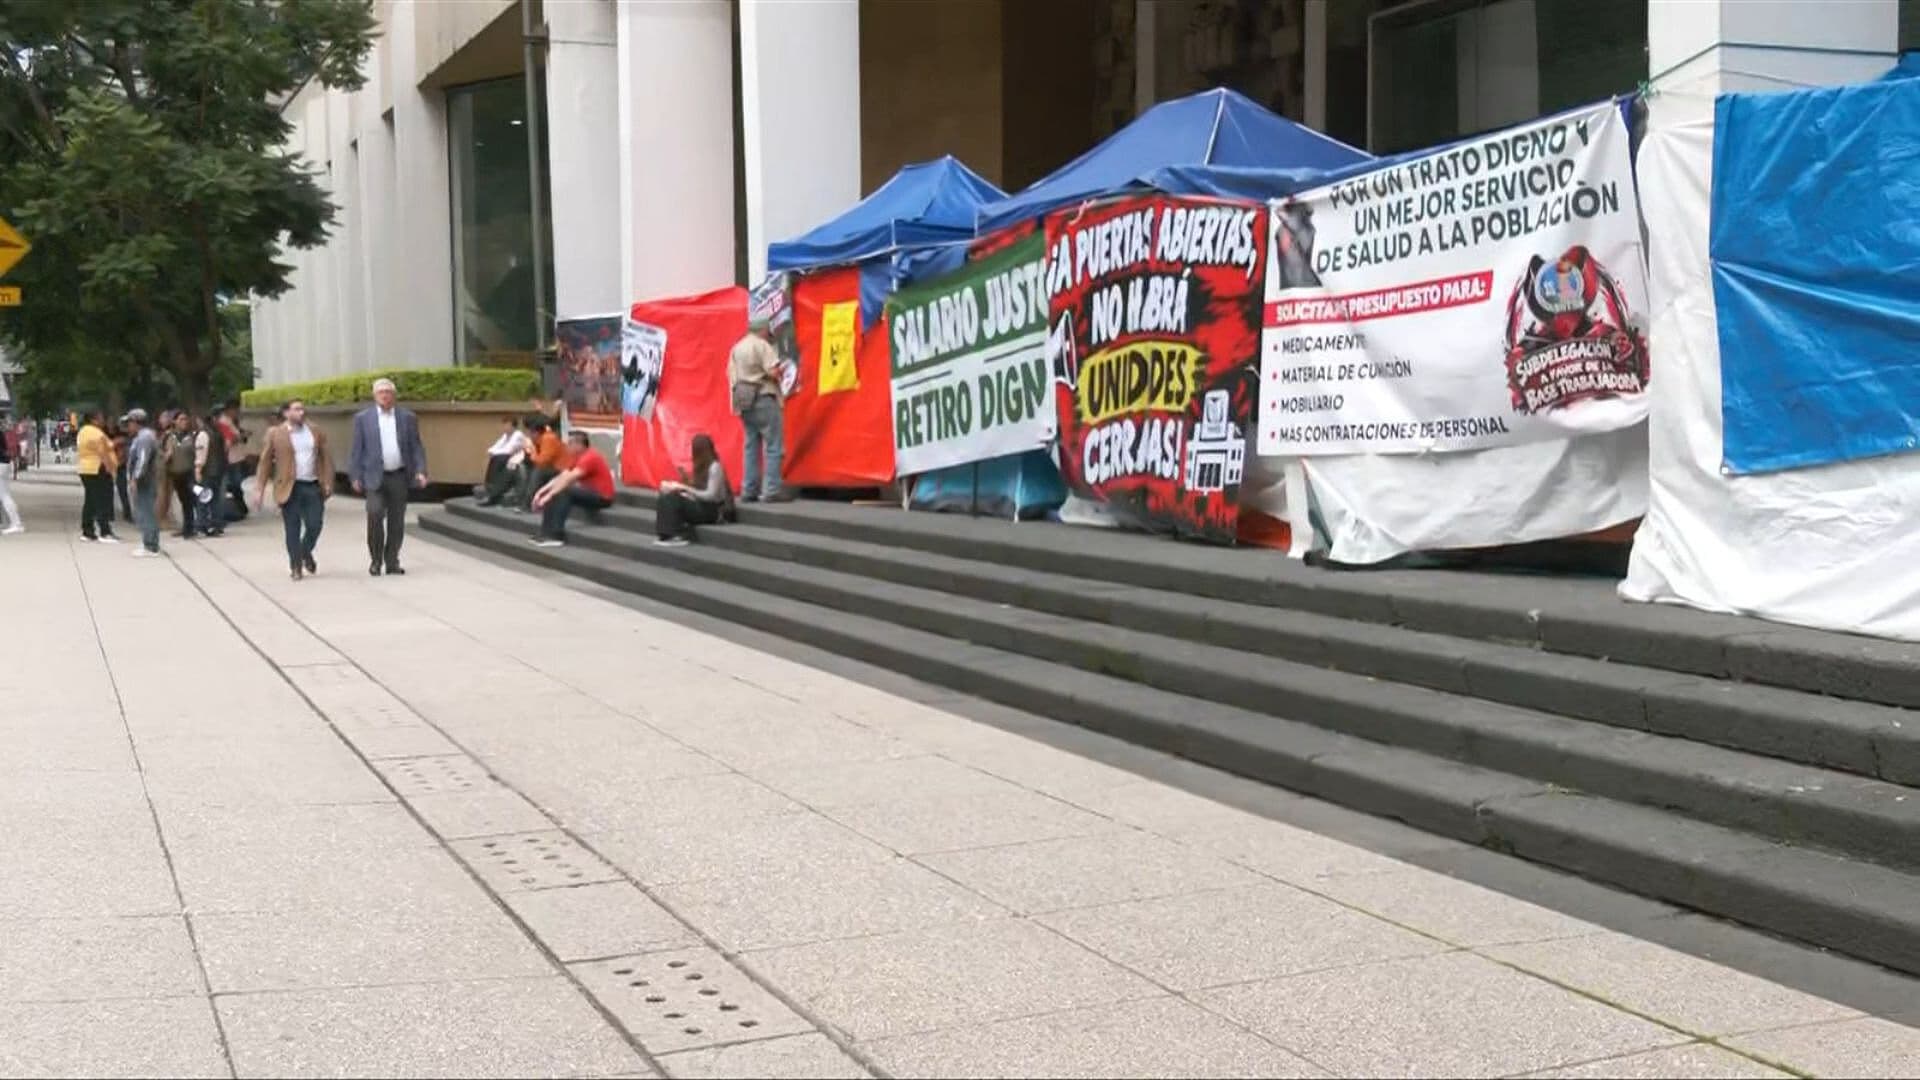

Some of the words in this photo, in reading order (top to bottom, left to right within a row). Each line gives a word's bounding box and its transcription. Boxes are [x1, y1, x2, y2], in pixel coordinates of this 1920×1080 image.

[1355, 205, 1381, 236] UN
[1387, 188, 1456, 229] MEJOR
[1462, 158, 1575, 211] SERVICIO
[1372, 168, 1402, 198] UN
[1408, 148, 1481, 190] TRATO
[1484, 125, 1567, 169] DIGNO
[1075, 206, 1153, 286] PUERTAS
[1156, 206, 1257, 280] ABIERTAS,
[1317, 246, 1343, 273] DE
[1347, 231, 1413, 270] SALUD
[1418, 227, 1434, 255] A
[1438, 219, 1468, 252] LA
[1471, 180, 1619, 245] POBLACIÓN
[893, 285, 979, 369] SALARIO
[1091, 283, 1123, 345] NO
[1349, 284, 1441, 319] PRESUPUESTO
[1442, 277, 1486, 304] PARA:
[896, 379, 973, 449] RETIRO
[978, 357, 1048, 431] DIGN
[1280, 394, 1344, 413] MOBILIARIO
[1281, 365, 1333, 384] MATERIAL
[1337, 363, 1355, 380] DE
[1279, 426, 1302, 442] MAS
[1304, 422, 1418, 443] CONTRATACIONES
[1420, 422, 1435, 438] DE
[1436, 416, 1509, 438] PERSONAL
